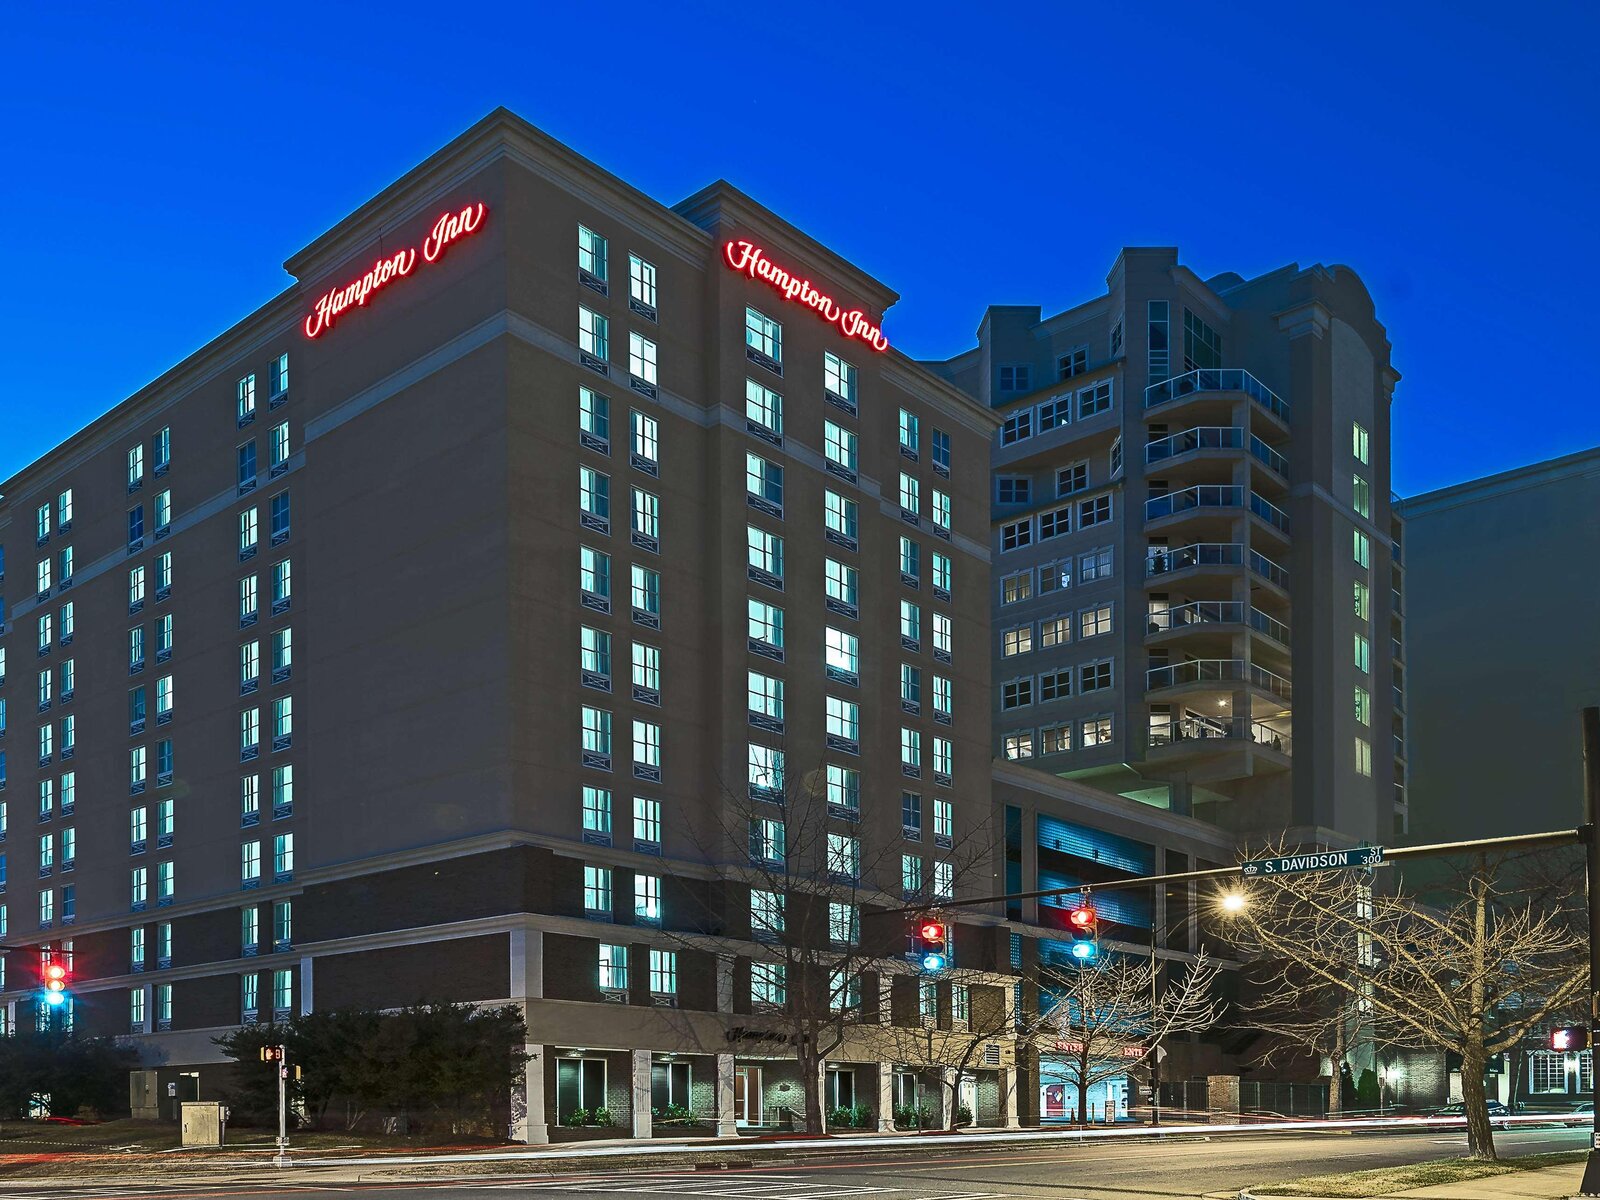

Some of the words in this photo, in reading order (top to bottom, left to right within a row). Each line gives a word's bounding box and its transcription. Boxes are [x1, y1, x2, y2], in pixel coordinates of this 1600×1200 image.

[304, 248, 418, 338] Hampton
[423, 202, 486, 262] Inn
[725, 240, 840, 322] Hampton
[841, 310, 888, 351] Inn
[1369, 846, 1381, 856] ST
[1264, 860, 1277, 873] S.
[1281, 852, 1348, 871] DAVIDSON
[1361, 855, 1382, 865] 300
[1124, 1047, 1146, 1057] ENTE
